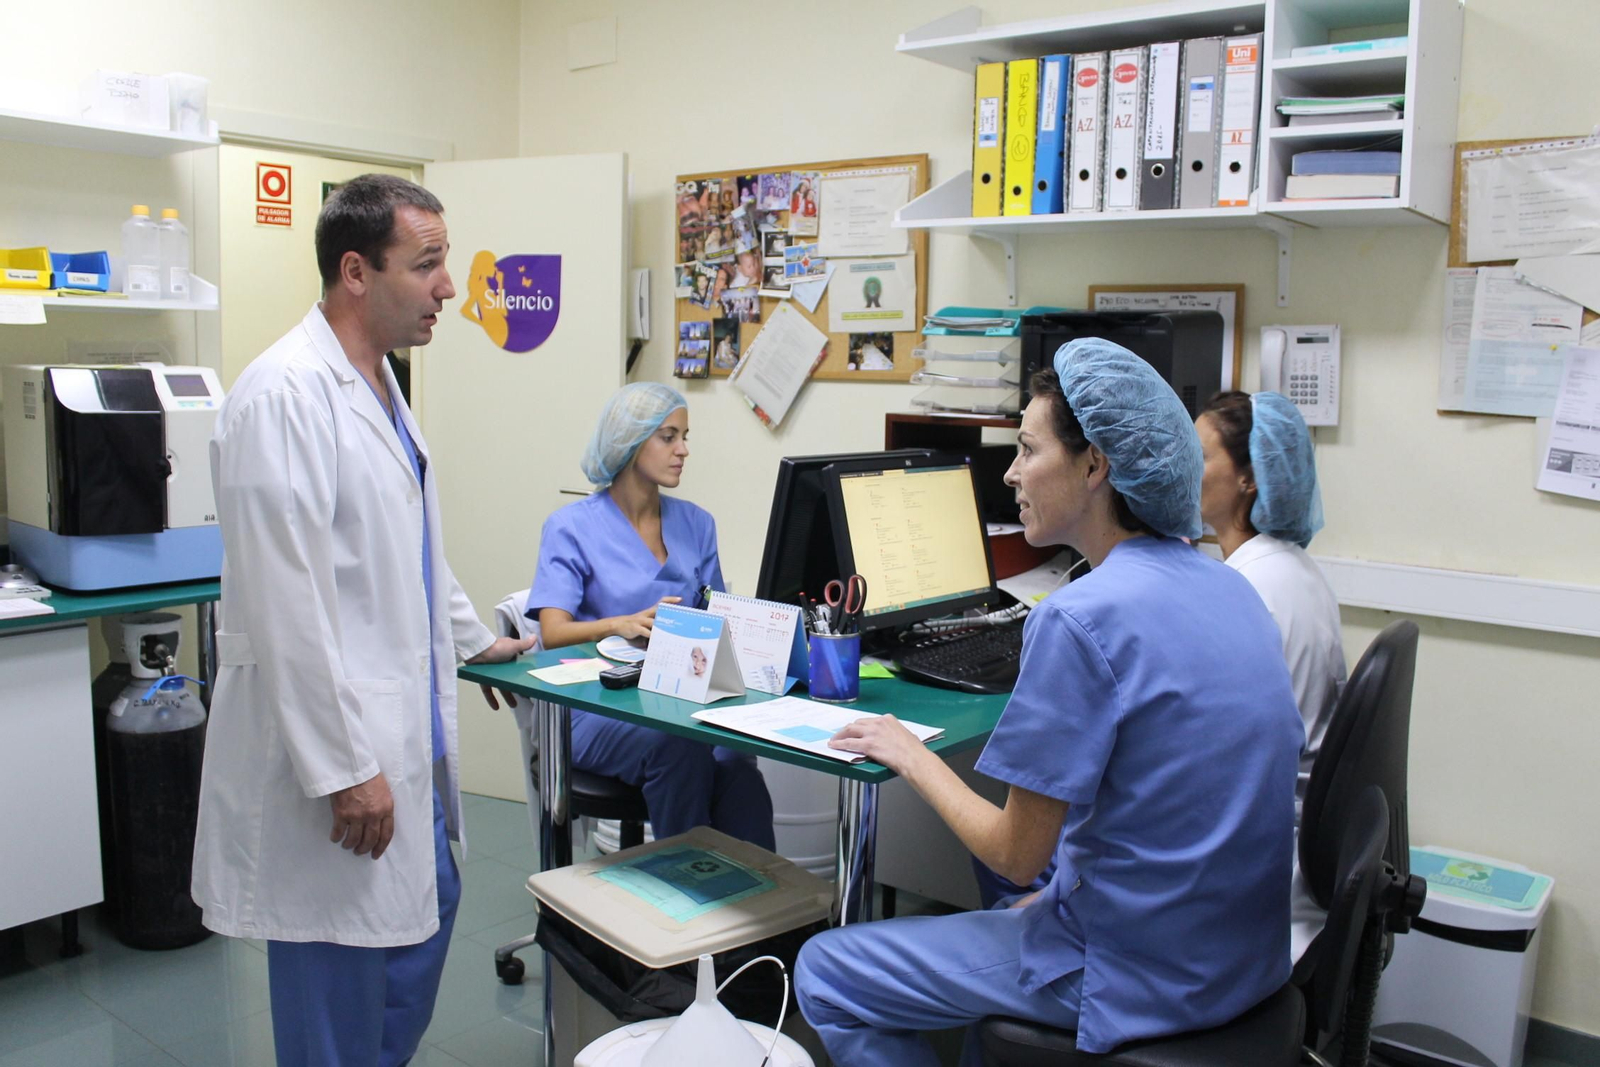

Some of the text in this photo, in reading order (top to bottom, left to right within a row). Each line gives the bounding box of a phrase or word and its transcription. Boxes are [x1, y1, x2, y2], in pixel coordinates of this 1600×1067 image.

[1232, 47, 1250, 57] Uni
[674, 181, 698, 194] GQ
[258, 207, 289, 216] PULSADOR
[257, 214, 290, 224] DE ALARMA
[484, 288, 553, 311] Silencio
[770, 611, 789, 621] 2017
